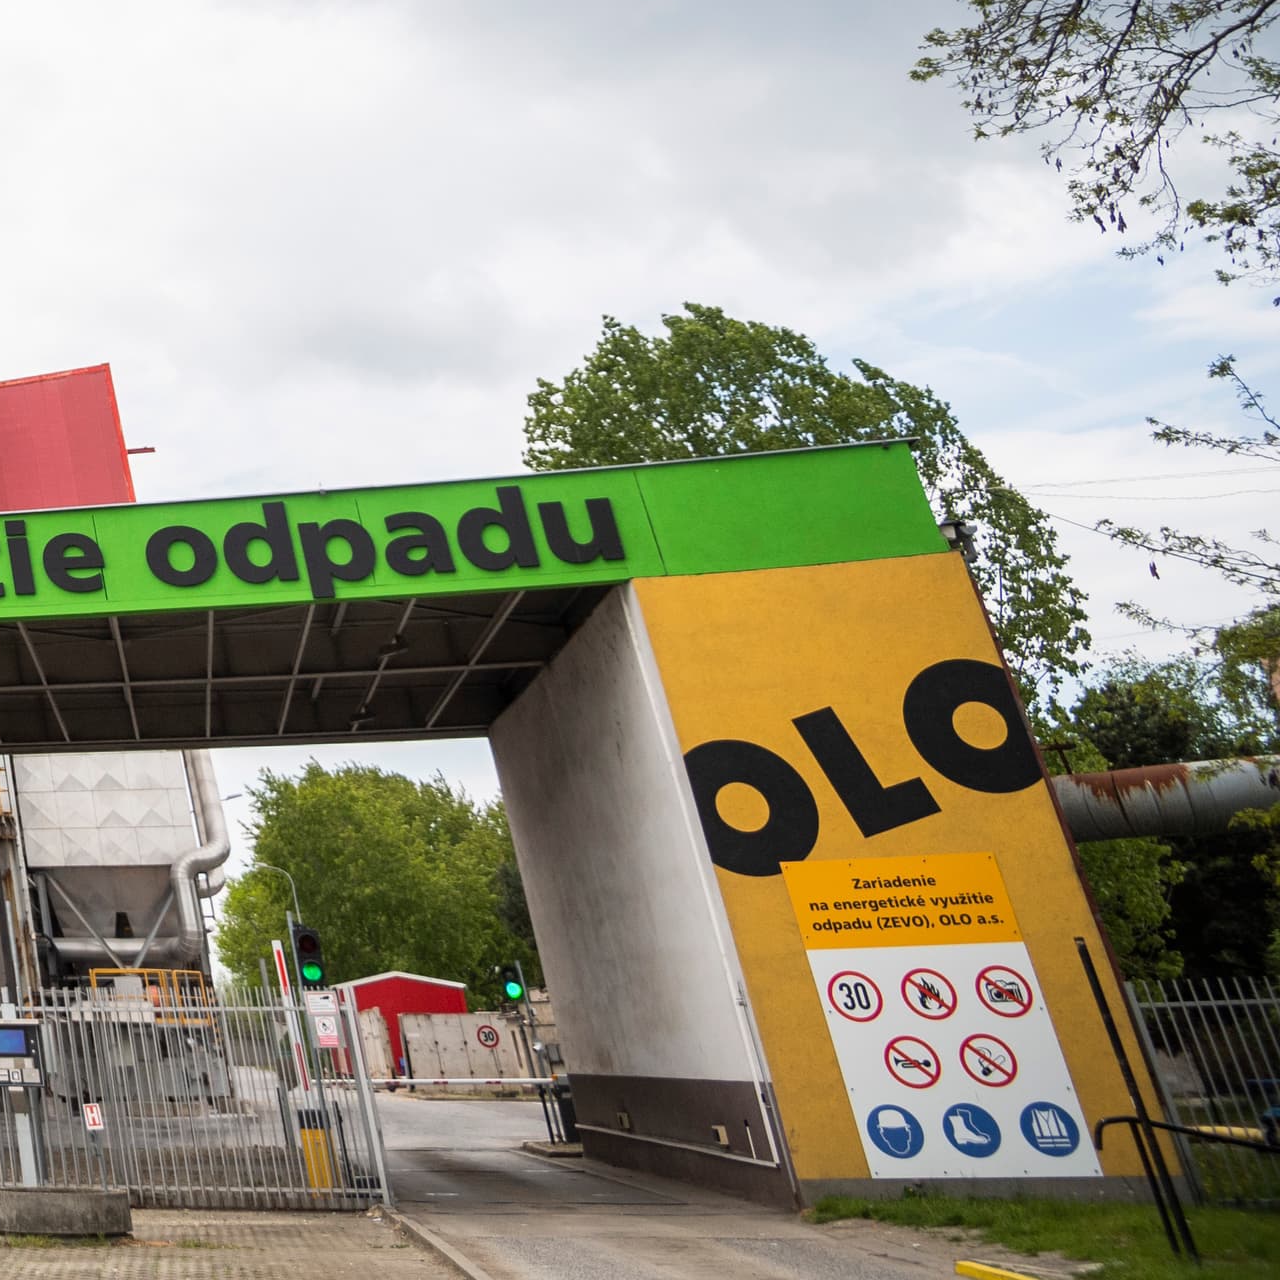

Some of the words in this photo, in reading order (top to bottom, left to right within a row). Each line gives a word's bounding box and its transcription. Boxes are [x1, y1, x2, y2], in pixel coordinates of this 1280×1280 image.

[145, 486, 627, 599] odpadu
[683, 658, 1045, 877] OLO
[851, 876, 937, 890] Zariadenie
[809, 901, 829, 912] na
[833, 895, 927, 913] energetické
[930, 893, 995, 908] využitie
[812, 917, 873, 934] odpadu
[876, 914, 935, 931] (ZEVO),
[938, 914, 972, 926] OLO
[977, 914, 1005, 925] a.s.
[838, 982, 871, 1010] 30
[481, 1030, 495, 1042] 30
